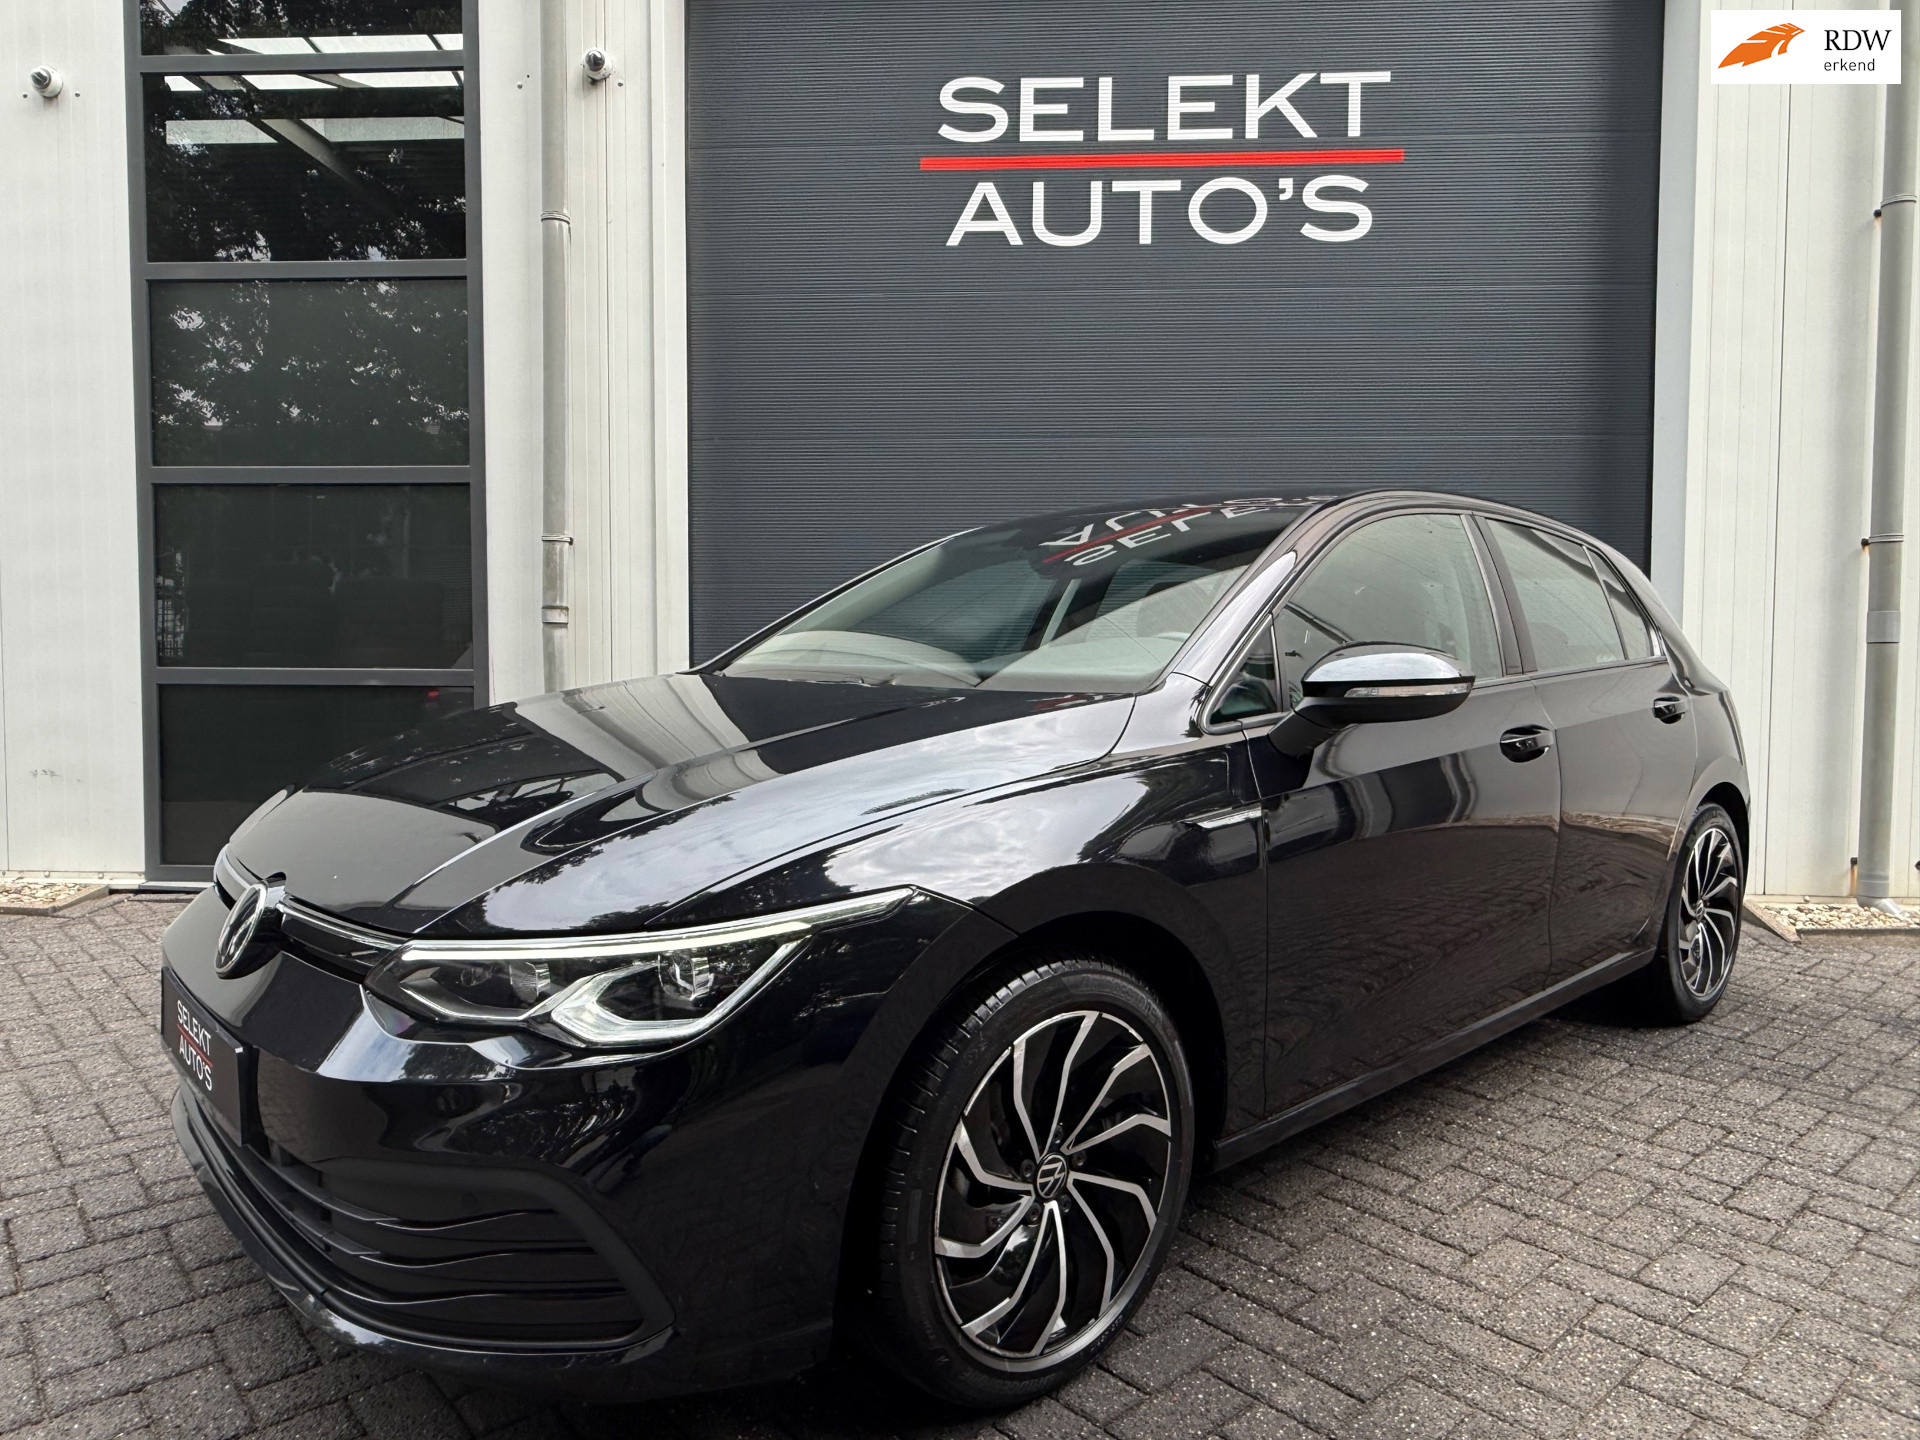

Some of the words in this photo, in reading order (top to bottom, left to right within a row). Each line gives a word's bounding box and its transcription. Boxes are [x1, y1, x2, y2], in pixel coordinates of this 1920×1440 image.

[937, 71, 1392, 143] SELEKT
[945, 174, 1373, 247] AUTO'S
[177, 999, 212, 1056] SELEKT
[179, 1034, 212, 1092] AUTO'S
